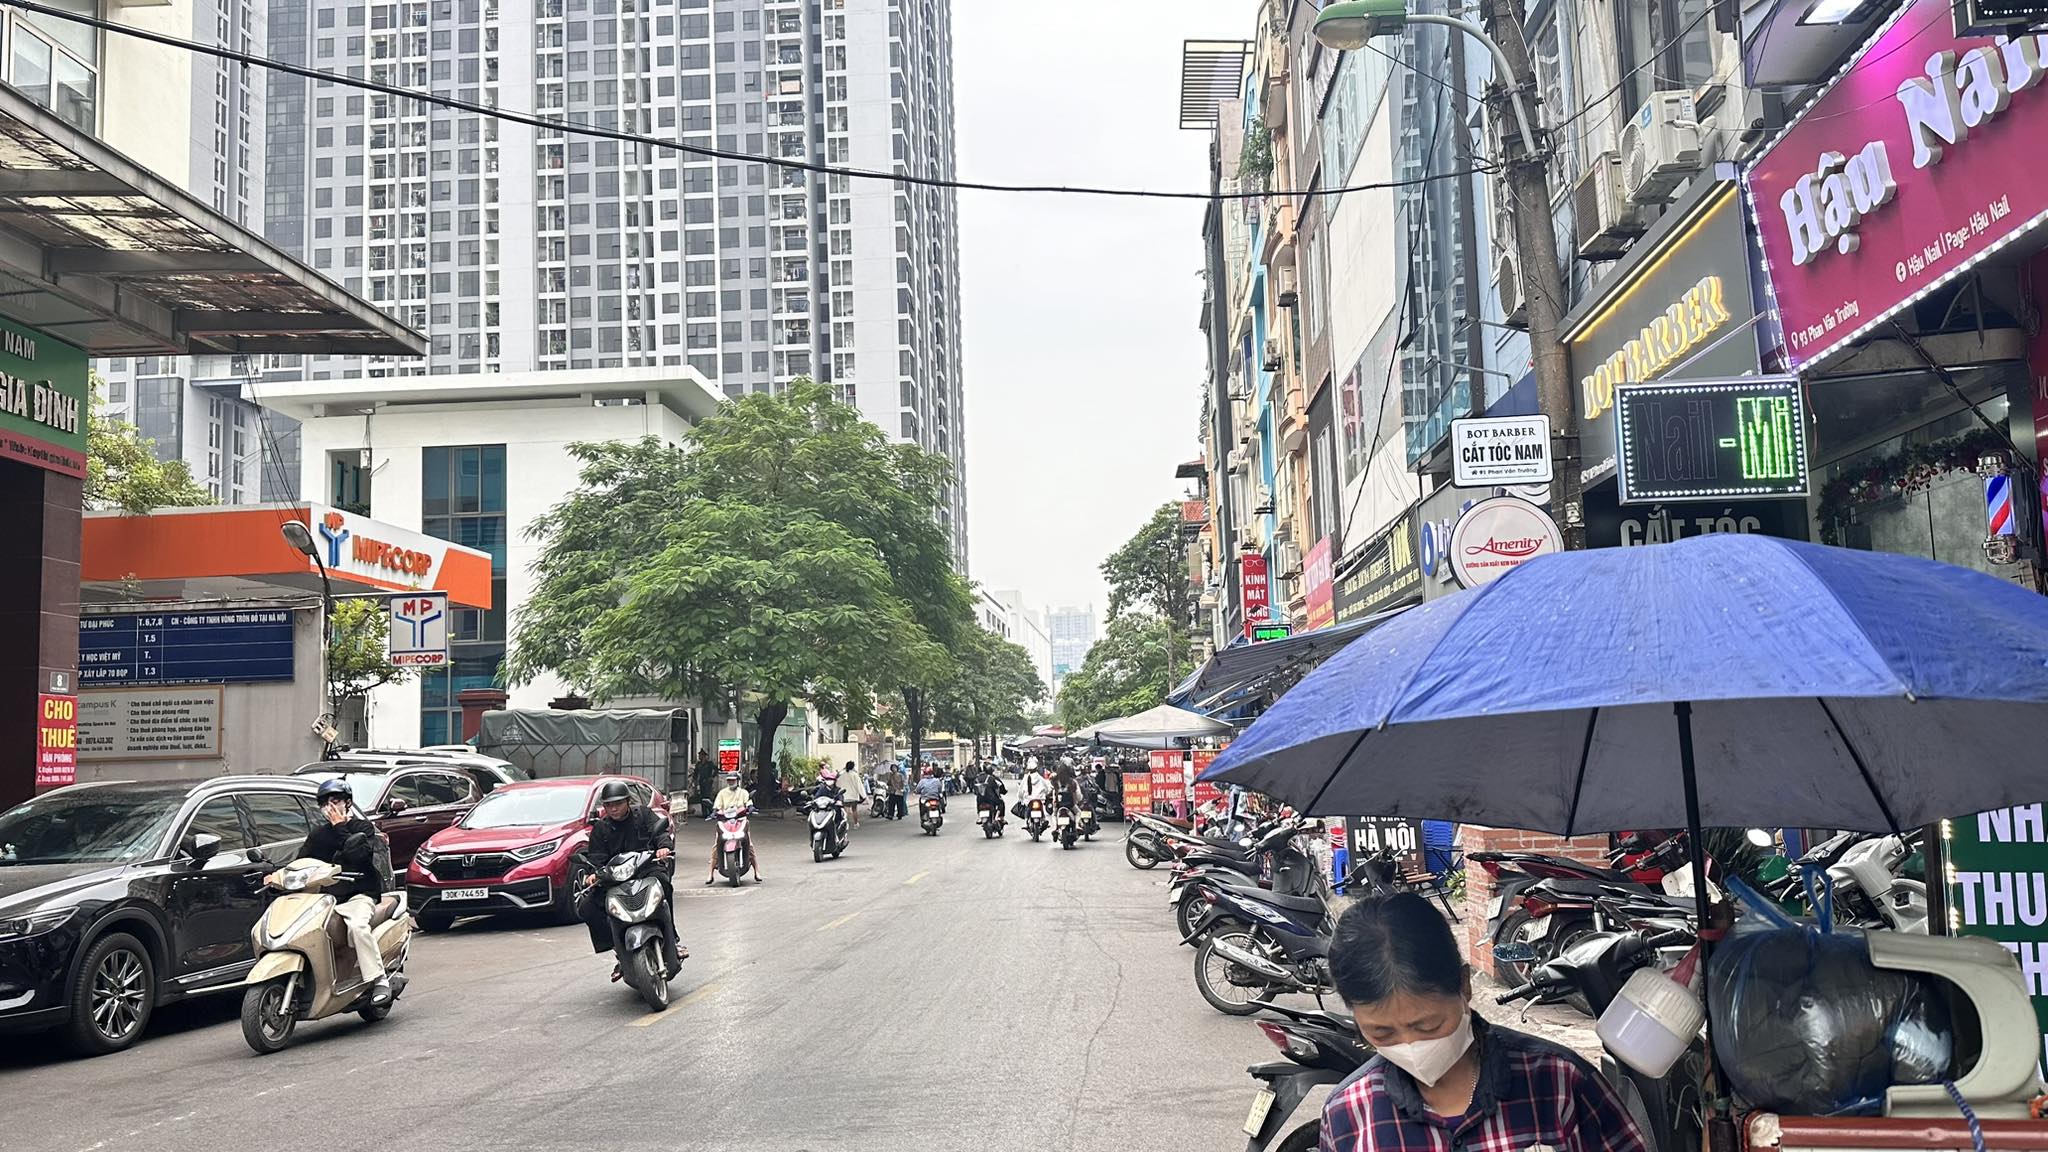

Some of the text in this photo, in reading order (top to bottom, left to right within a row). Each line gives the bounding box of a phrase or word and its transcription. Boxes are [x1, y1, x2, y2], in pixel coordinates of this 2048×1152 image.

[1780, 140, 1896, 266] Hậu
[1907, 254, 1924, 276] Hậu
[1924, 240, 1942, 266] Nail
[1945, 227, 1970, 252] Page:
[1969, 212, 1990, 236] Hậu
[1989, 194, 2011, 222] Nail
[1808, 324, 1824, 342] Phan
[5, 330, 36, 360] NAM
[1581, 275, 1730, 420] BOT BARBER
[34, 380, 80, 434] ĐÌNH
[1467, 428, 1536, 438] BOT BARBER
[1462, 442, 1543, 463] CẮT TÓC NAM
[1474, 537, 1544, 555] Amenity
[352, 535, 432, 576] MIPECORP
[1245, 572, 1266, 585] KÍNH
[1247, 586, 1264, 600] MẮT
[184, 616, 198, 624] CÔNG
[200, 616, 205, 624] TY
[144, 634, 156, 642] T.5
[144, 651, 151, 659] T.
[392, 654, 444, 664] MIPECORP
[144, 668, 156, 676] T.3
[56, 674, 62, 687] 8
[44, 700, 73, 720] CHO
[111, 700, 117, 708] K
[41, 724, 76, 748] THUÊ
[1152, 756, 1164, 768] MUA
[1170, 754, 1182, 768] BÁN
[1152, 770, 1164, 784] SỬA
[1166, 771, 1182, 784] CHỮA
[1124, 782, 1138, 792] KÍNH
[1154, 786, 1182, 798] LẤY NGAY
[1977, 802, 2048, 842] NH
[1354, 822, 1416, 855] HÀ NỘI
